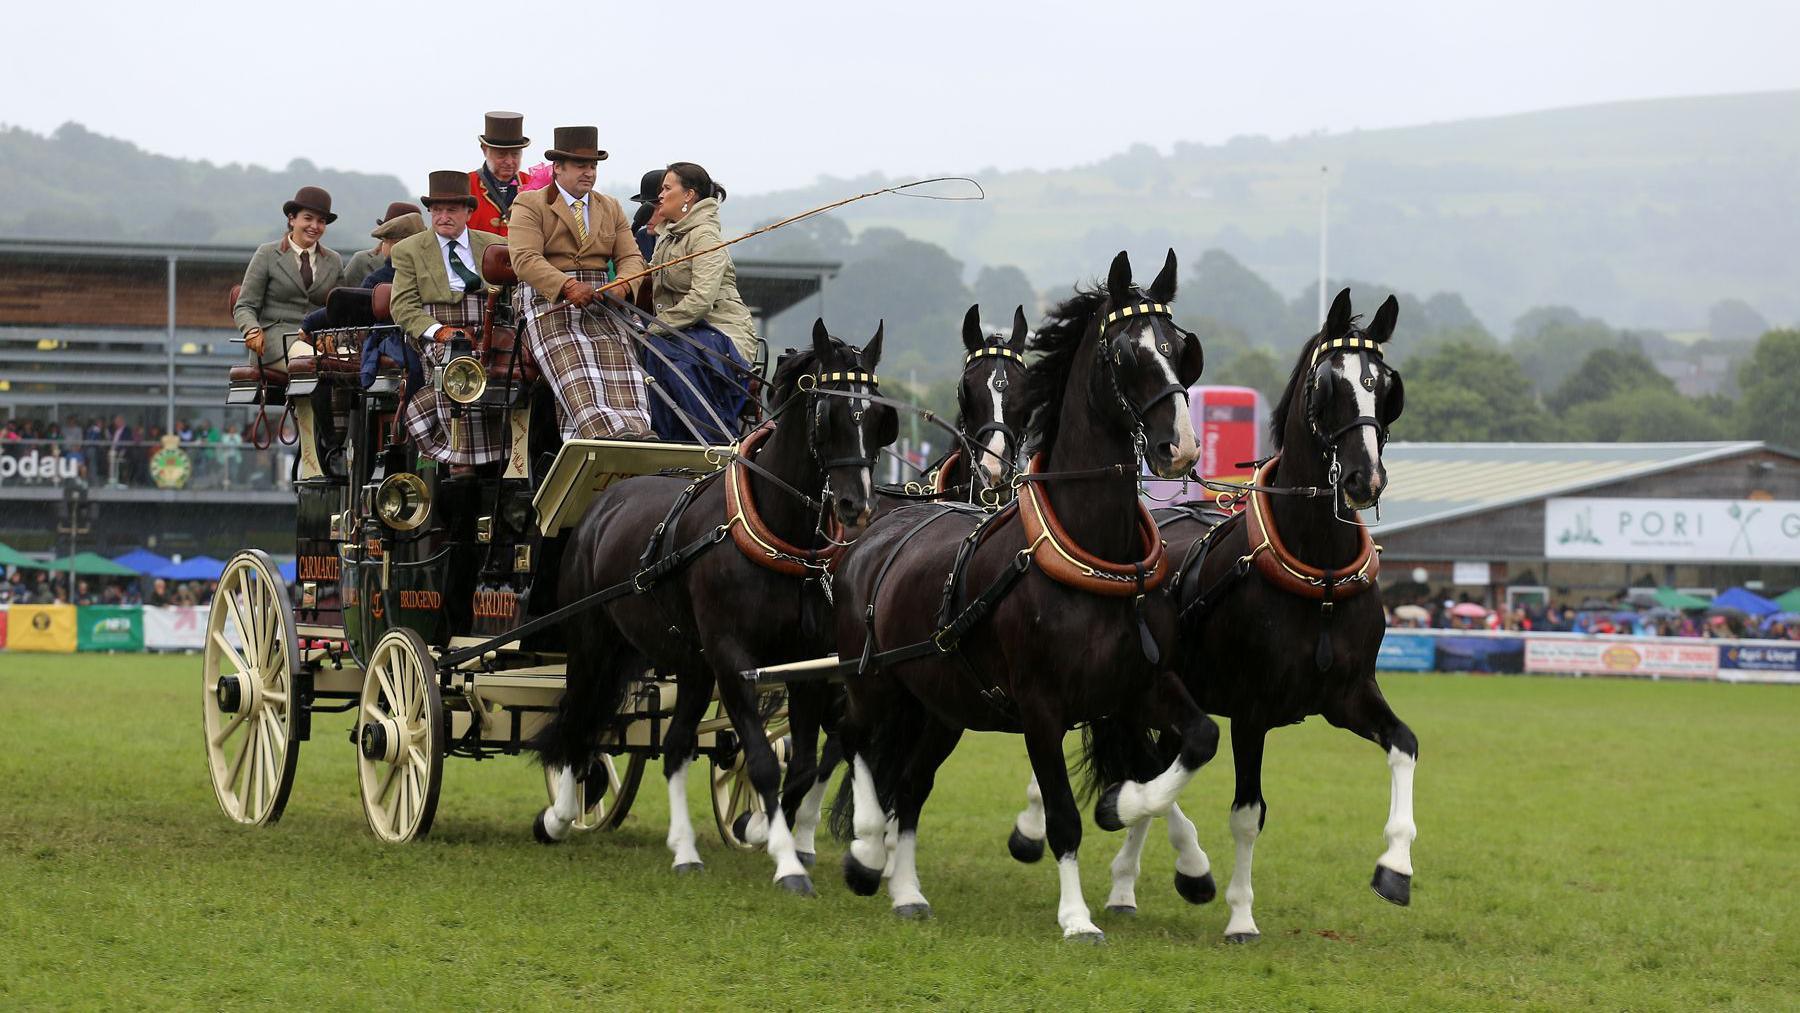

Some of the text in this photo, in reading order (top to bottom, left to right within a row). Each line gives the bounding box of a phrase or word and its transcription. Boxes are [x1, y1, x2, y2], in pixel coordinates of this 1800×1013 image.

[1364, 377, 1374, 387] T
[854, 411, 863, 421] T
[1618, 510, 1703, 537] PORI
[400, 590, 441, 609] BRIDGEND
[473, 591, 517, 617] CARDIFF
